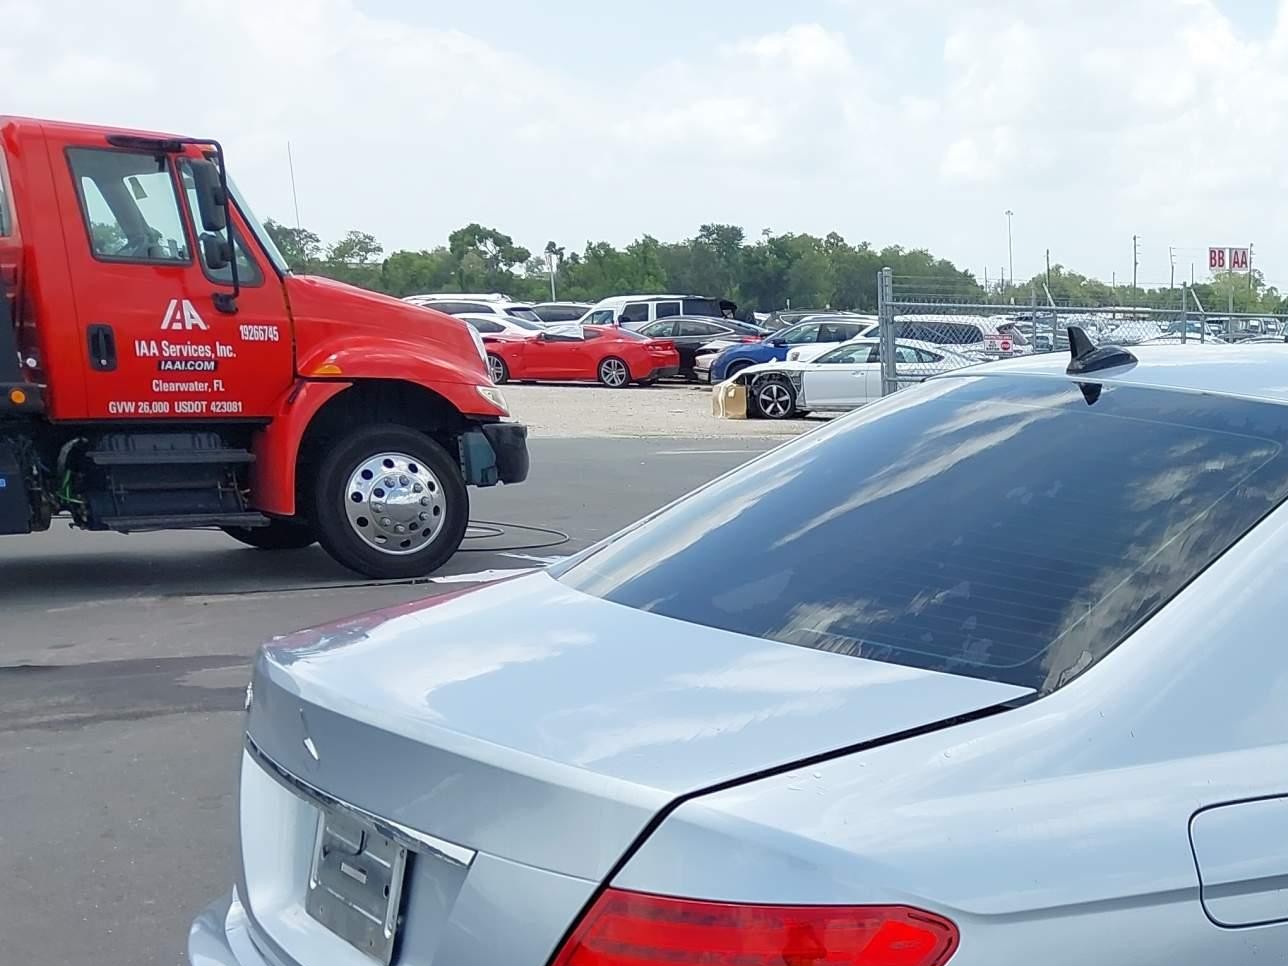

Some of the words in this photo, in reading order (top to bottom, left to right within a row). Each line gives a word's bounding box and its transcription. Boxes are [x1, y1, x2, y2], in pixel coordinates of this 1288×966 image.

[1210, 249, 1225, 268] BB
[1232, 250, 1248, 268] AA
[240, 325, 279, 341] 19266745
[135, 340, 159, 357] IAA
[161, 340, 215, 359] Services,
[216, 341, 236, 358] Inc.
[161, 360, 215, 371] IAAI.COM
[152, 379, 211, 393] Clearwater,
[213, 379, 225, 392] FL
[108, 401, 135, 414] GVW
[138, 402, 169, 414] 26,000
[175, 401, 207, 413] USDOT
[210, 401, 242, 413] 423081
